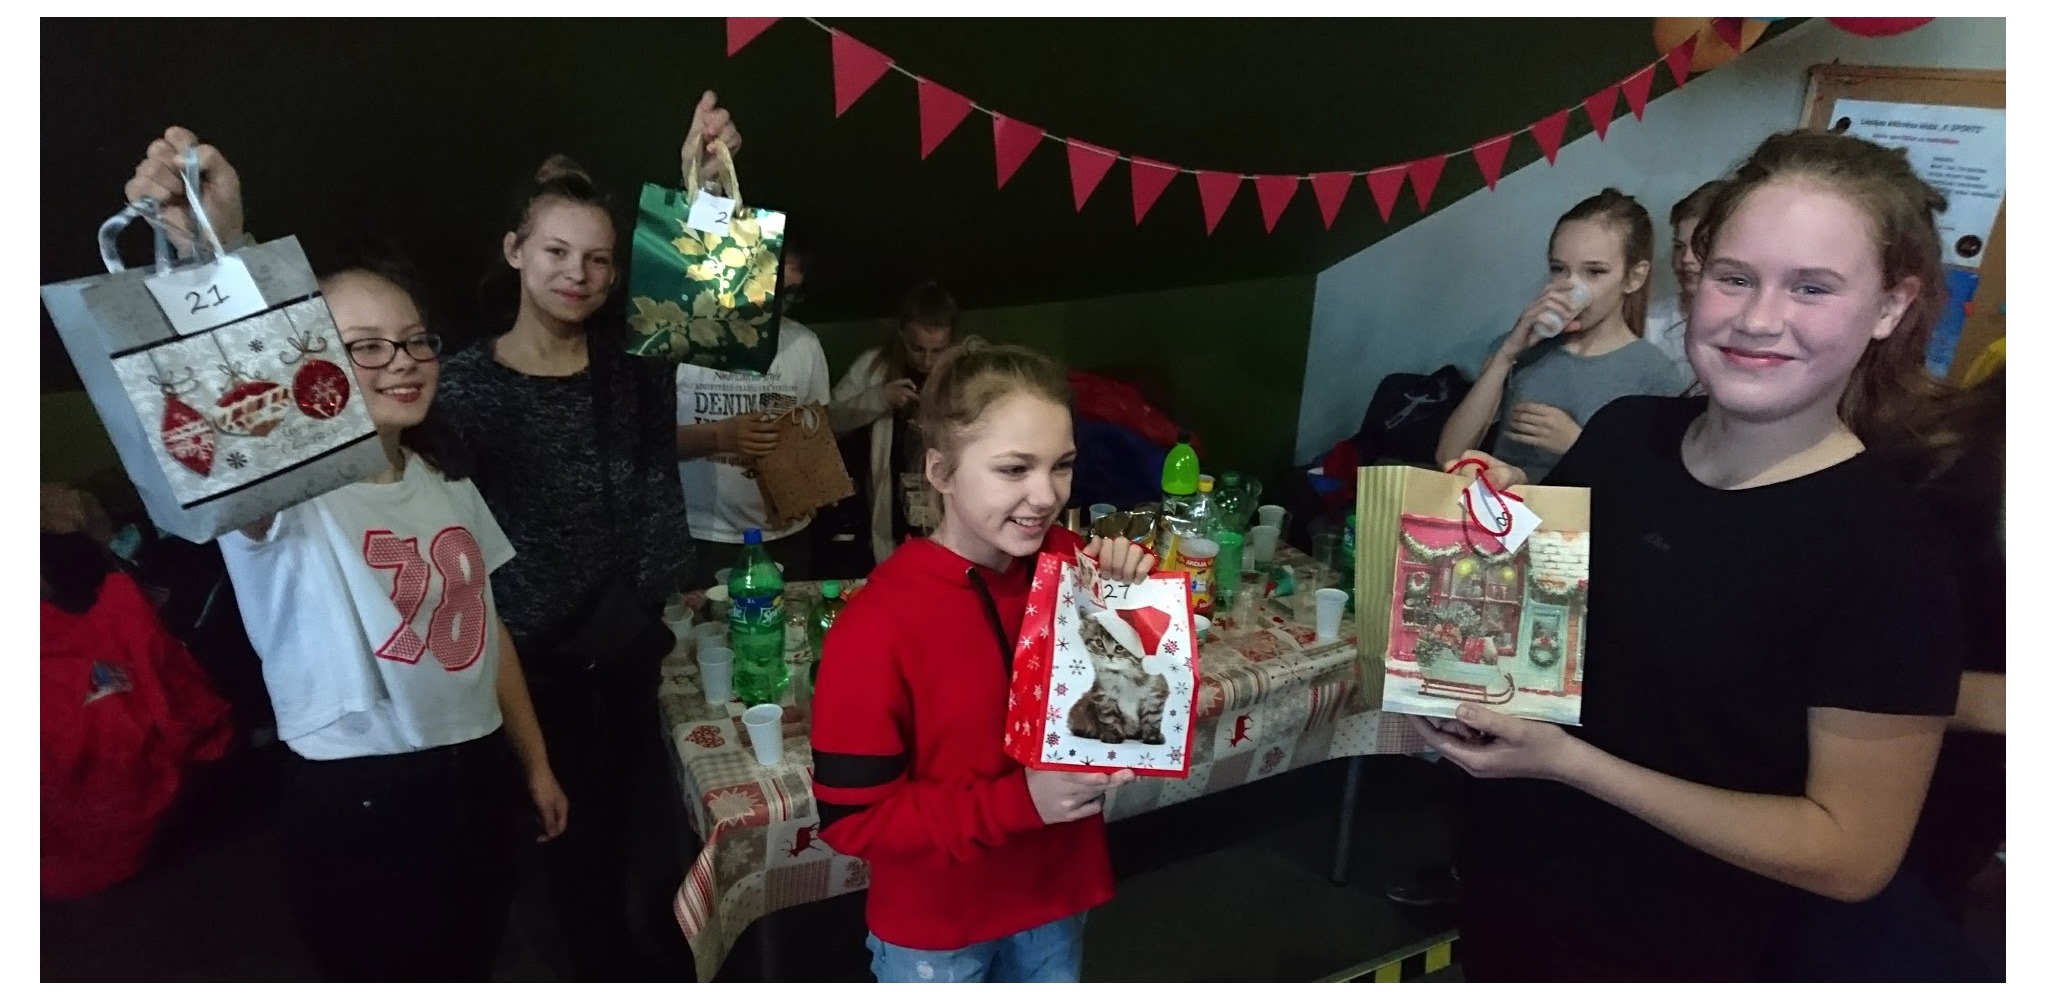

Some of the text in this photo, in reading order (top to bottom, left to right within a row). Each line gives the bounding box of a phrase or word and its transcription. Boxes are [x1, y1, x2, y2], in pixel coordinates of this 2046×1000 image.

[715, 211, 728, 225] 2
[184, 284, 230, 315] 21
[694, 391, 757, 416] DENIM
[1104, 583, 1131, 600] 27
